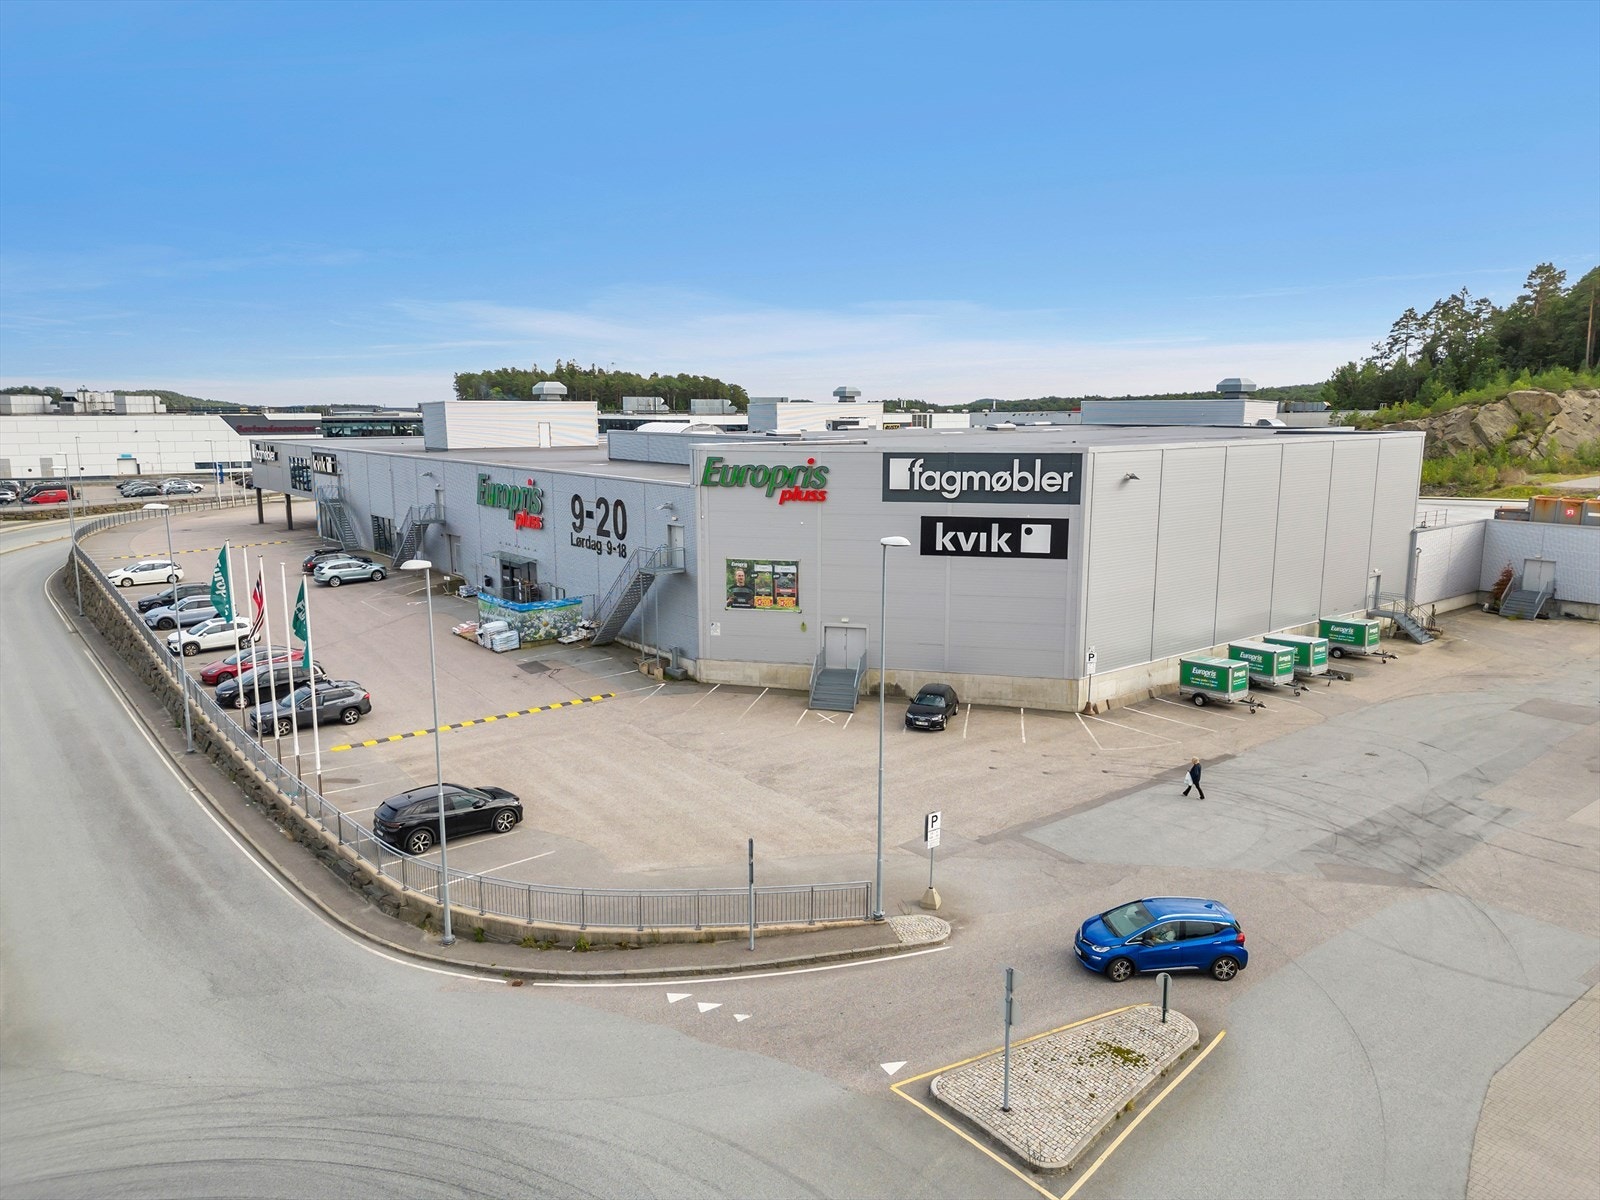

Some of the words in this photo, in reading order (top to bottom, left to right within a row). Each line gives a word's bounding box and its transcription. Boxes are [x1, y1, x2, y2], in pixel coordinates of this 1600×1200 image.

[701, 457, 829, 497] Europris
[911, 458, 1073, 499] fagmøbler
[477, 473, 543, 520] Europris
[779, 486, 827, 505] pluss
[514, 508, 544, 530] pluss
[571, 494, 627, 540] 9-20
[570, 532, 602, 555] Lørdag
[606, 541, 627, 558] 9-18
[936, 522, 1012, 552] kvik
[1192, 667, 1216, 677] Europris
[931, 815, 938, 828] P
